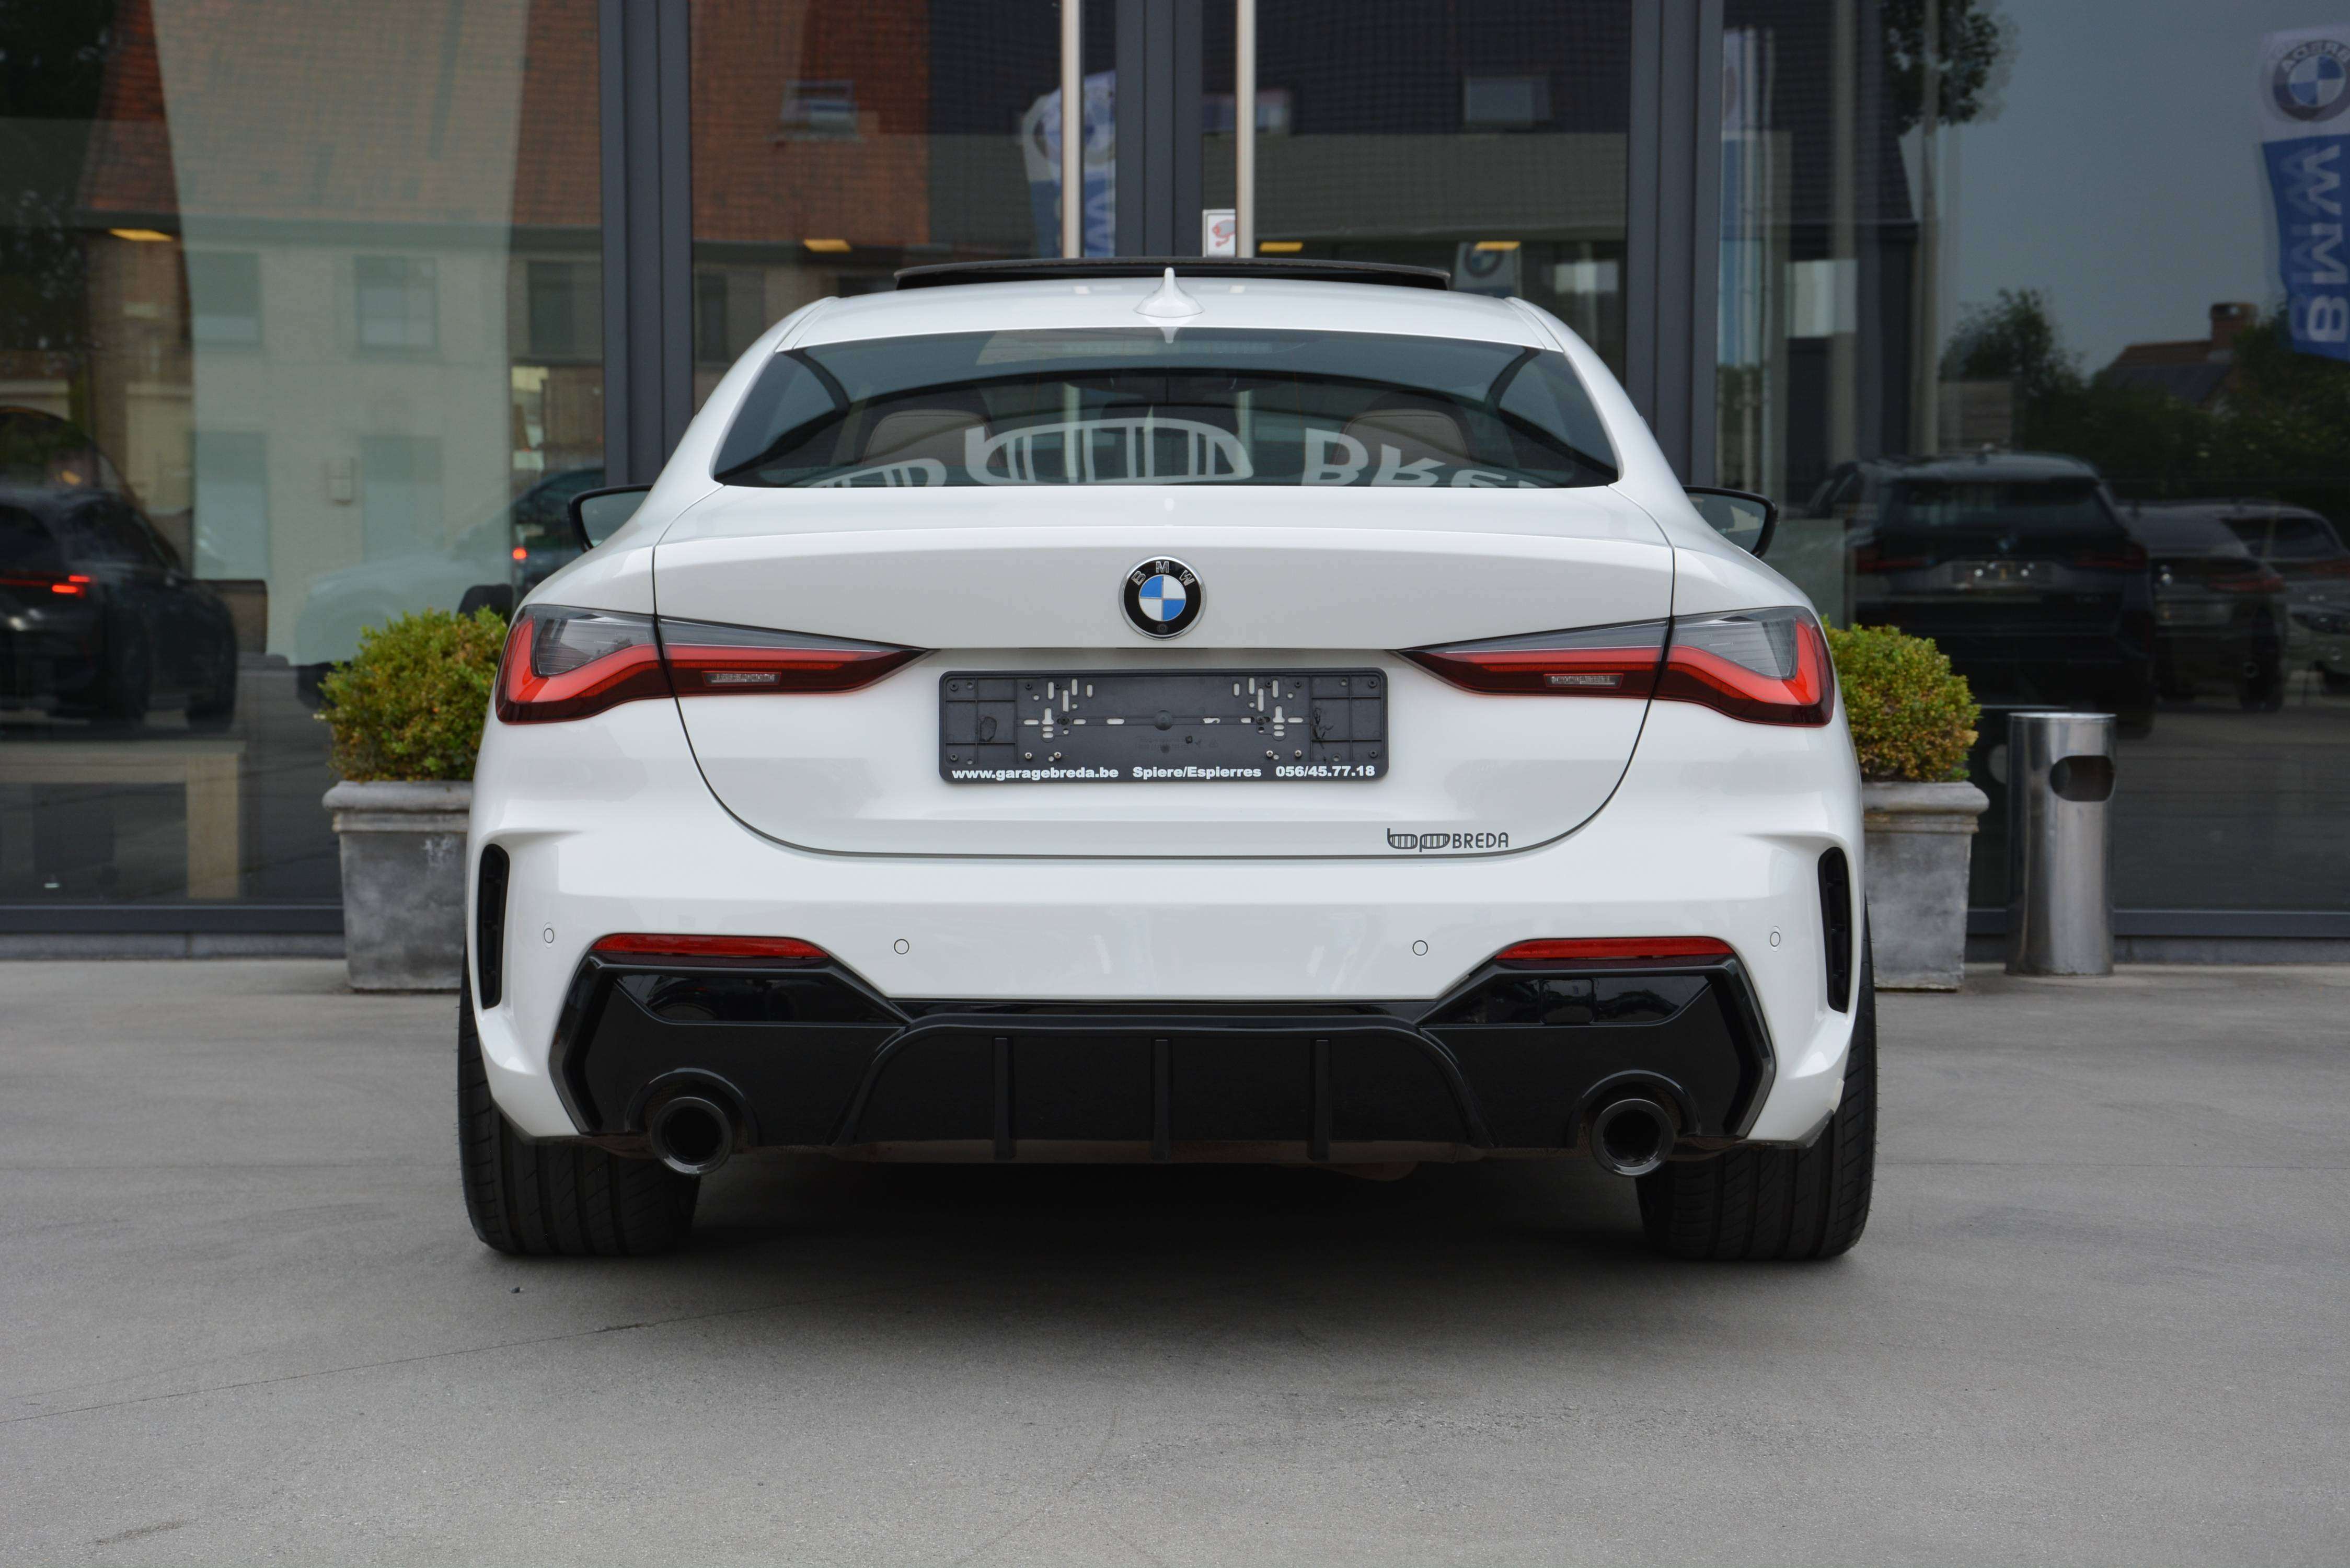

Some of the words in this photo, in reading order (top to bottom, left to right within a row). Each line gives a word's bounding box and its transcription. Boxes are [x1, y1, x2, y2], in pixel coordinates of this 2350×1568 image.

[1131, 561, 1195, 586] BMW
[951, 767, 1119, 781] www.garagebreda.be
[1133, 766, 1262, 780] Spiere/Espierres
[1275, 765, 1375, 777] 056/45.77.18
[1453, 832, 1509, 849] BREDA
